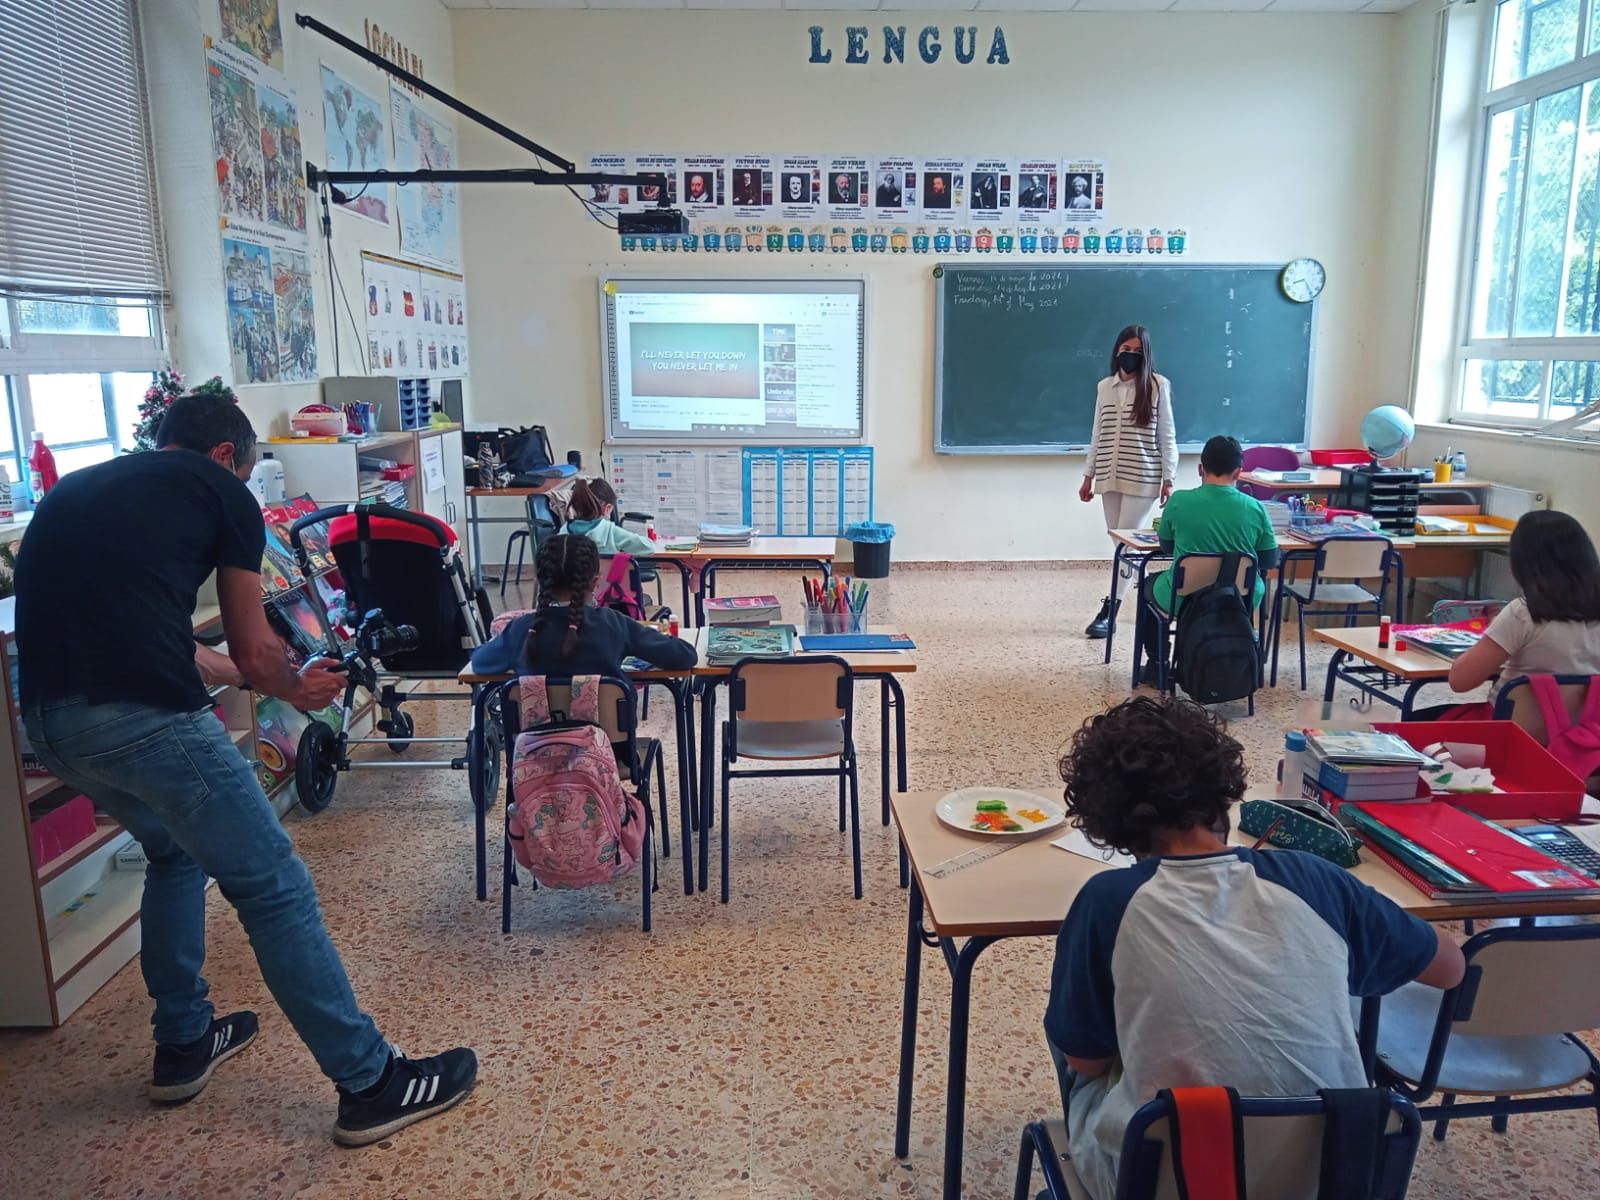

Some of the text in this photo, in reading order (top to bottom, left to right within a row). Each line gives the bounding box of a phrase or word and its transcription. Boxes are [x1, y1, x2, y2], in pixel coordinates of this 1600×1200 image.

[808, 26, 1010, 64] LENGUA
[658, 350, 685, 360] NEVER
[686, 351, 701, 360] LET
[702, 351, 720, 360] YOU
[720, 351, 746, 361] DOWN
[651, 362, 668, 371] YOU
[669, 362, 697, 371] NEVER
[698, 362, 714, 371] LET
